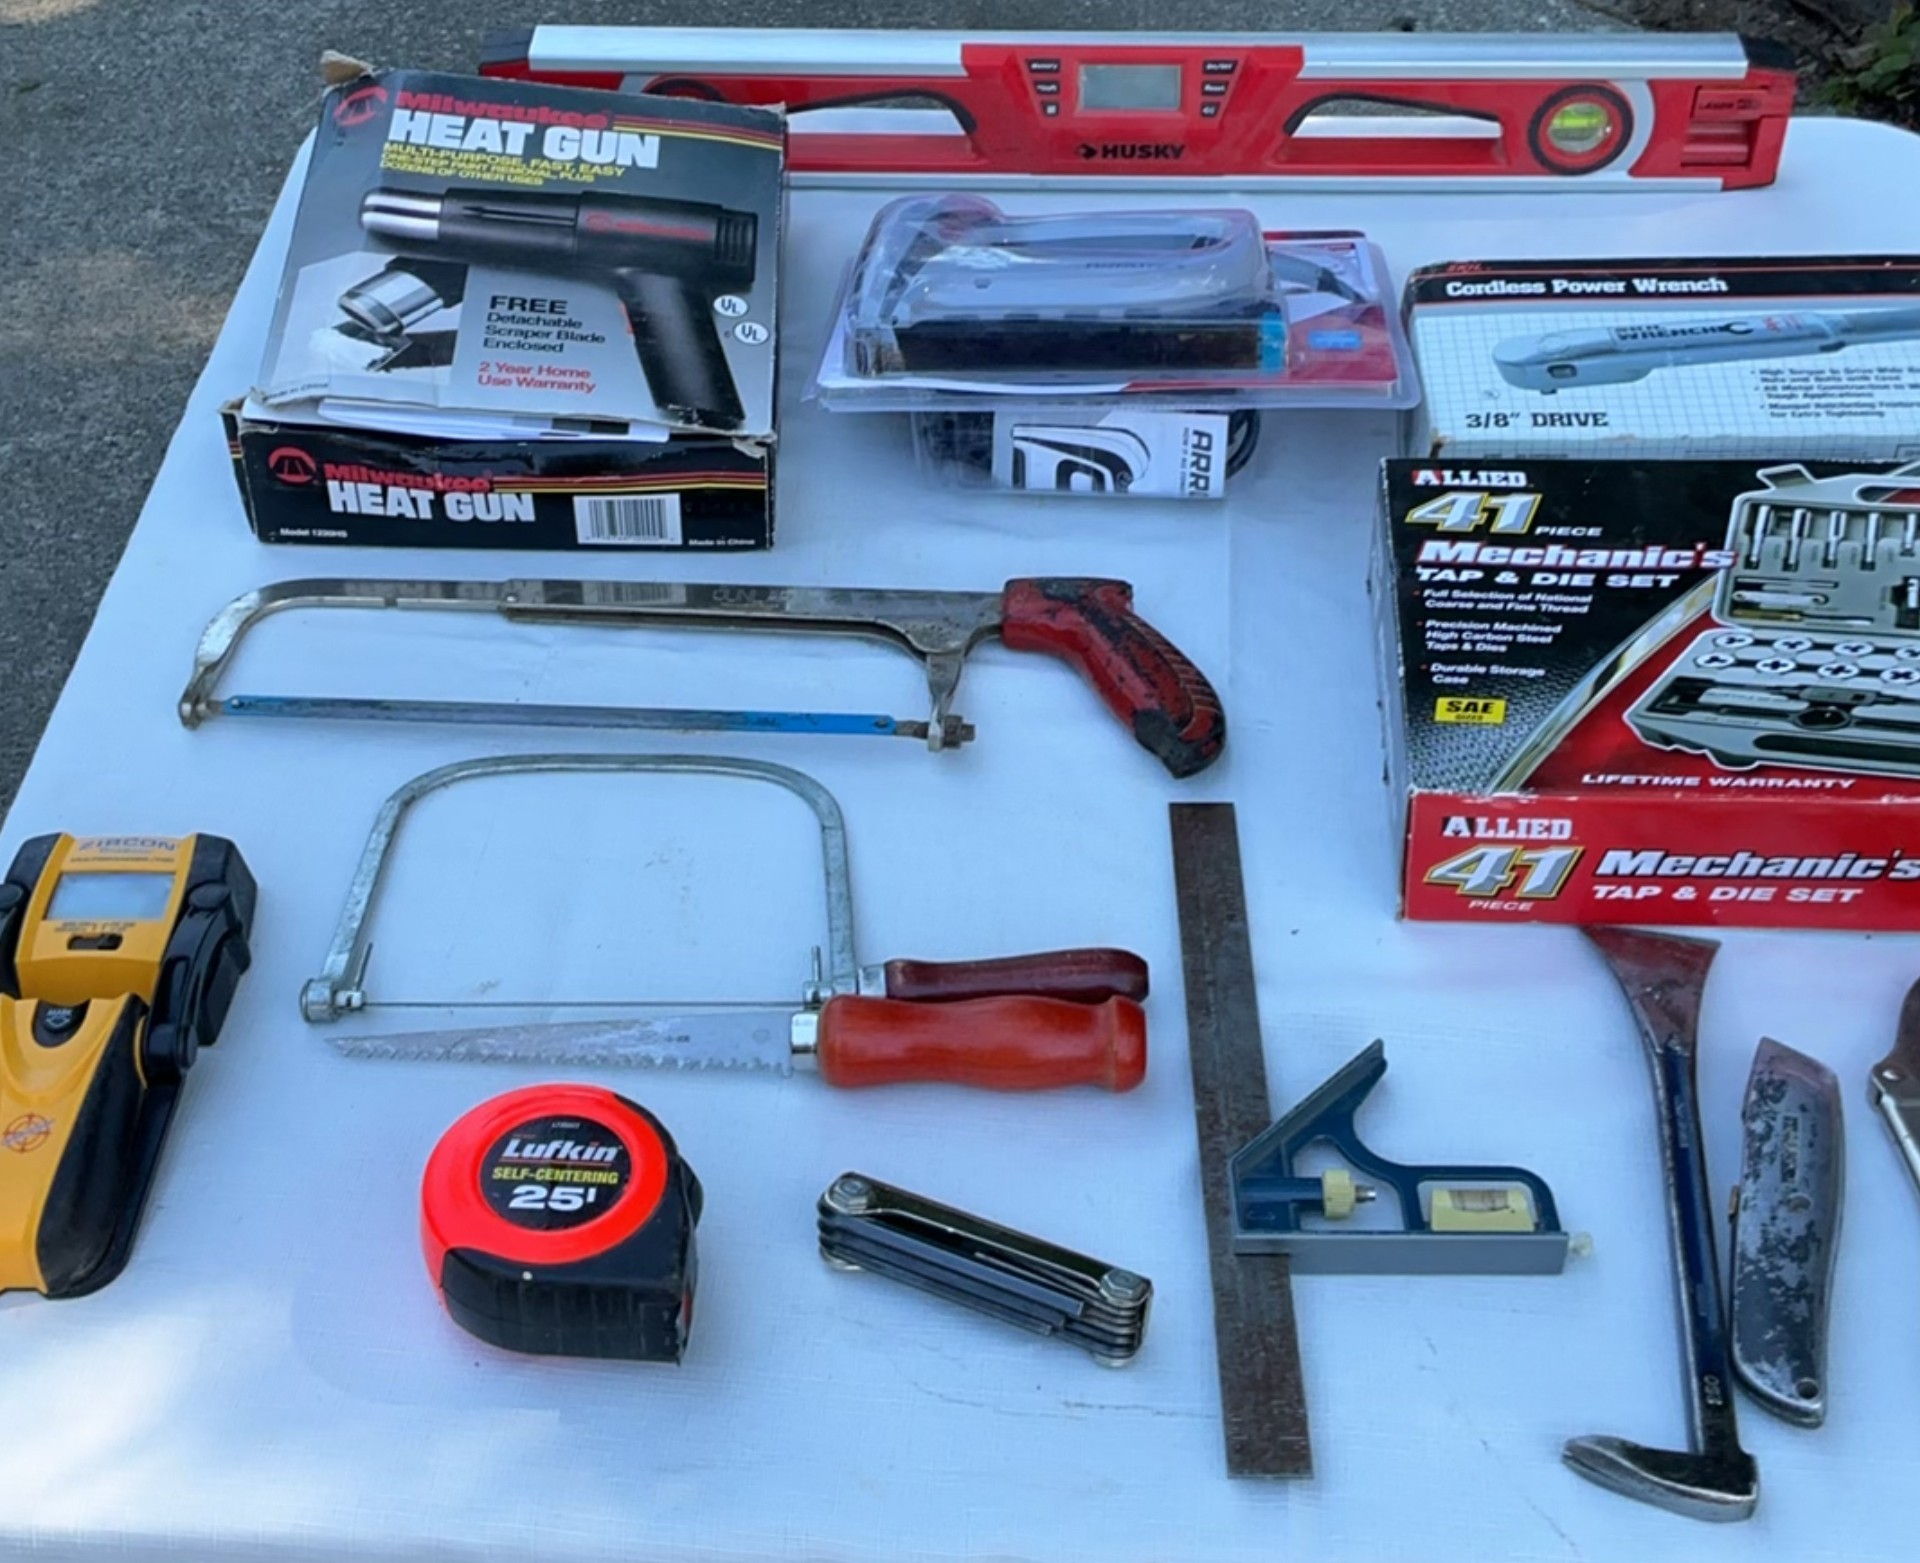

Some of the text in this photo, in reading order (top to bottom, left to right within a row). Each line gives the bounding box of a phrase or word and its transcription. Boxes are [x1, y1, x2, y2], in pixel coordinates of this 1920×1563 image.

[395, 91, 608, 128] Milwaukee
[388, 108, 660, 168] HEAT GUN
[1102, 144, 1185, 159] HUSKY
[437, 167, 454, 177] OF
[457, 169, 505, 181] OTHER
[506, 174, 544, 185] USES
[558, 172, 595, 183] PLUS
[579, 163, 626, 177] EASY
[1446, 277, 1728, 296] Cordless Power Wrench
[489, 295, 567, 315] FREE
[487, 311, 583, 329] Detachable
[485, 324, 605, 344] Scraper Blade
[483, 337, 564, 353] Enclosed
[478, 361, 591, 379] 2 Year Home
[478, 375, 596, 394] Use Warranty
[1530, 412, 1609, 427] DRIVE
[324, 463, 490, 491] Milwaukee
[1413, 470, 1528, 488] ALLIED
[327, 480, 536, 522] HEAT GUN
[1404, 491, 1543, 534] 41
[1534, 526, 1604, 537] PIECE
[1417, 540, 1738, 570] Mechanic's
[1415, 566, 1680, 588] TAP & DIE SET
[1423, 589, 1593, 603] Full Selection of National
[1425, 599, 1589, 614] Coarse and Fine Thread
[1425, 619, 1562, 633] Precision Machined
[1425, 630, 1553, 644] High Carbon Steel
[1426, 641, 1507, 652] Taps & Dies
[1430, 663, 1546, 678] Durable Storage
[1432, 674, 1469, 684] Case
[1445, 700, 1495, 714] SAE
[1581, 774, 1856, 789] LIFETIME WARRANTY
[1443, 816, 1573, 840] ALLIED
[80, 837, 175, 851] ZIRCON
[1422, 844, 1585, 899] 41
[1595, 849, 1920, 878] Mechanic's
[1592, 885, 1864, 902] TAP & DIE SET
[1468, 900, 1535, 912] PIECE
[502, 1138, 619, 1162] Lufkin
[492, 1166, 619, 1184] SELF-CENTERING
[508, 1184, 597, 1211] 25'
